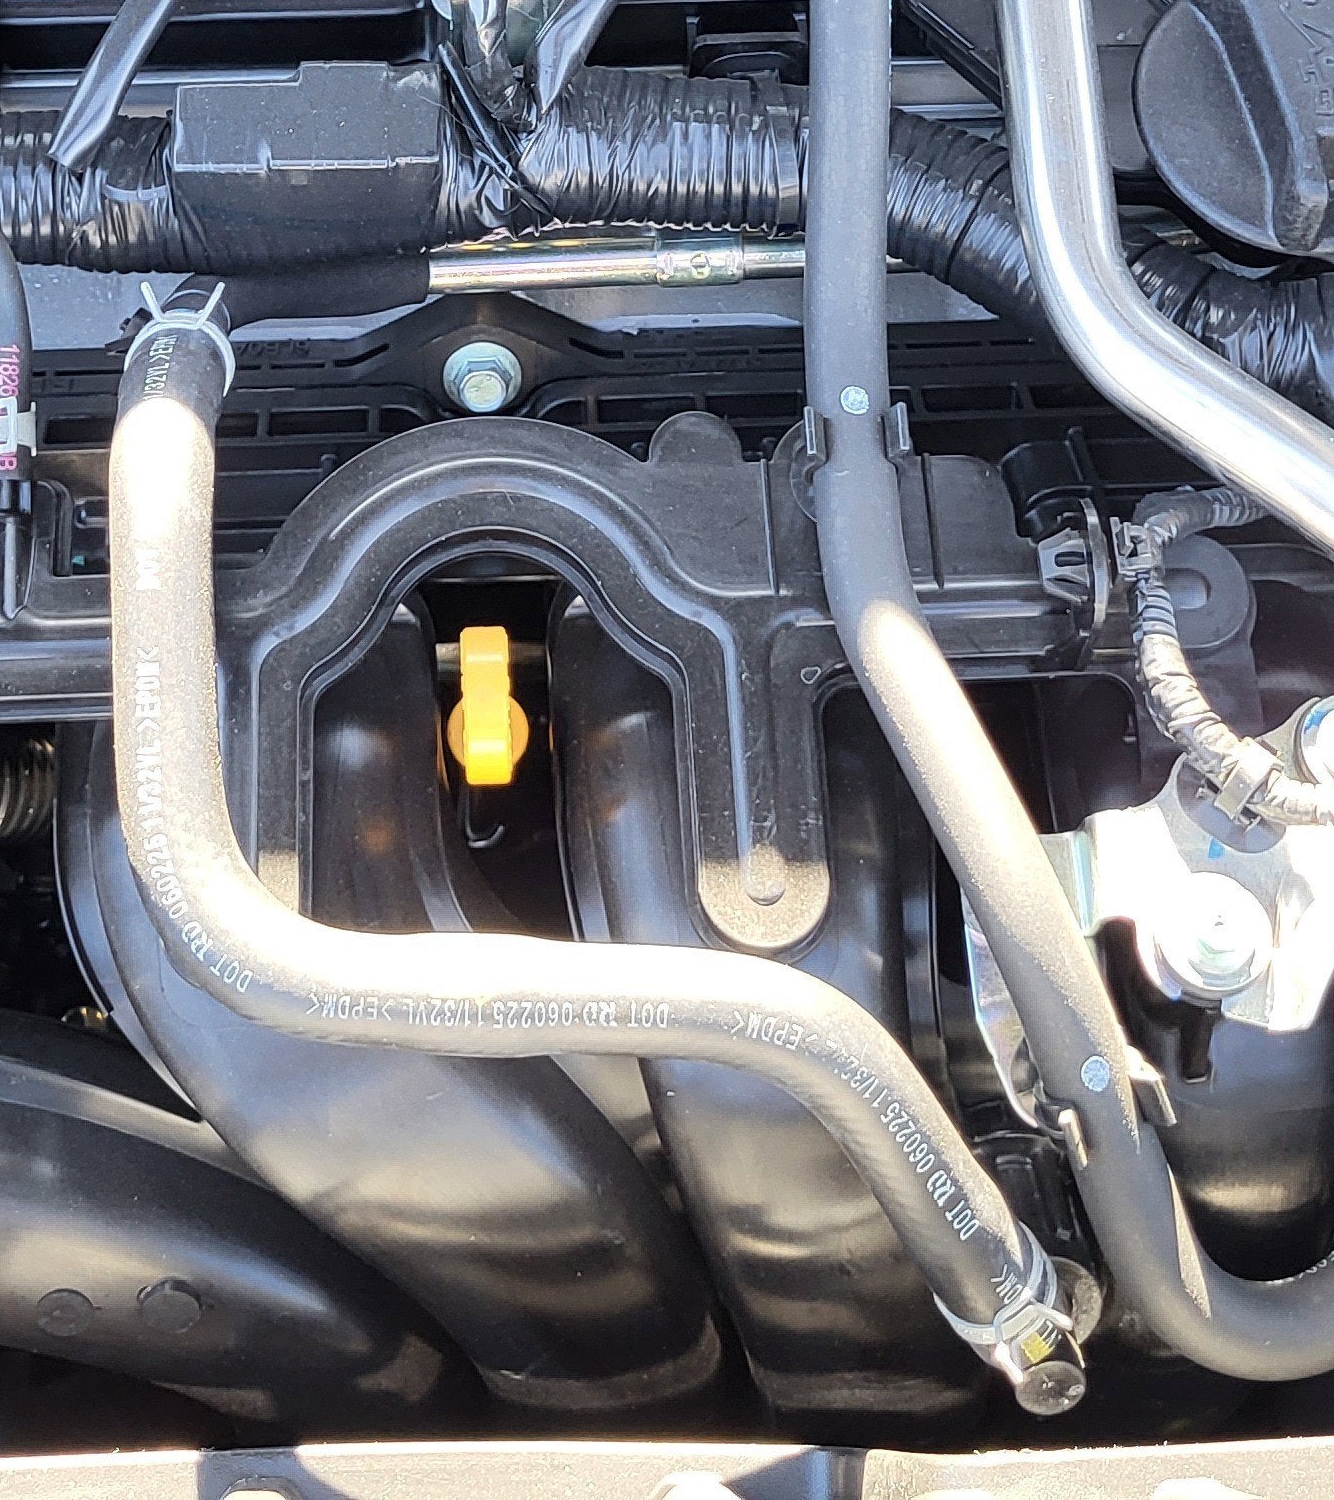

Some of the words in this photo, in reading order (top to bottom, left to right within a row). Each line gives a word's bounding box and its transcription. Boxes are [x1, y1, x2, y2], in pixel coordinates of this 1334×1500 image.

[209, 950, 255, 993] DOT
[627, 1000, 670, 1029] DOT
[944, 1199, 980, 1241] DOT
